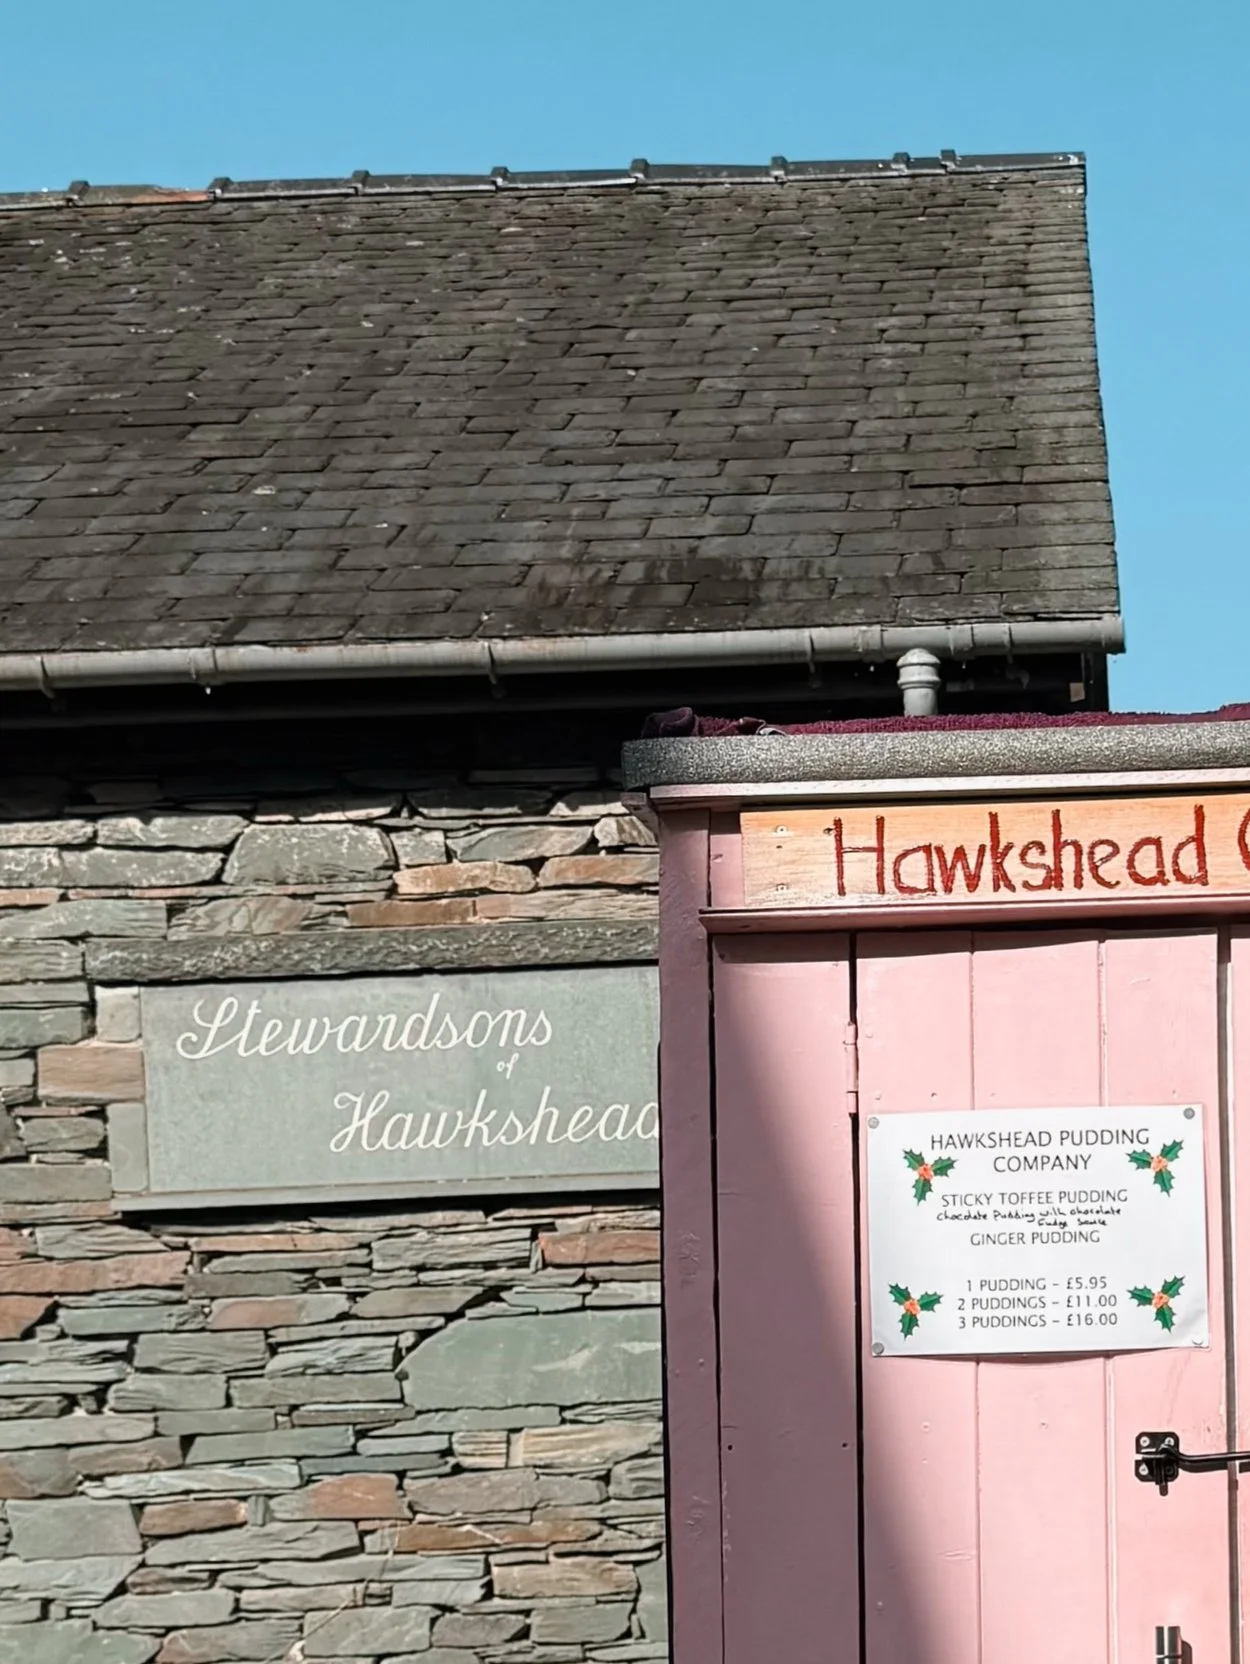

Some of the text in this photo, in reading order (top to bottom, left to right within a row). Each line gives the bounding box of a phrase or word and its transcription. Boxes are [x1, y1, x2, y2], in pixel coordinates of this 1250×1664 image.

[833, 805, 1207, 896] Hawkshead
[176, 993, 552, 1060] Stewardsons
[497, 1054, 519, 1079] of
[930, 1129, 1150, 1150] HAWKSHEAD PUDDING
[993, 1154, 1092, 1172] COMPANY
[941, 1189, 1128, 1207] STICKY TOFFEE PUDDING
[970, 1230, 1100, 1246] GINGER PUDDING
[980, 1278, 1046, 1291] PUDDING
[1066, 1276, 1107, 1290] £5.95
[957, 1298, 965, 1311] 2
[972, 1296, 1046, 1310] PUDDINGS
[1066, 1294, 1117, 1308] £11.00
[958, 1316, 966, 1329] 3
[972, 1314, 1046, 1328] PUDDINGS
[1067, 1313, 1118, 1326] £16.00
